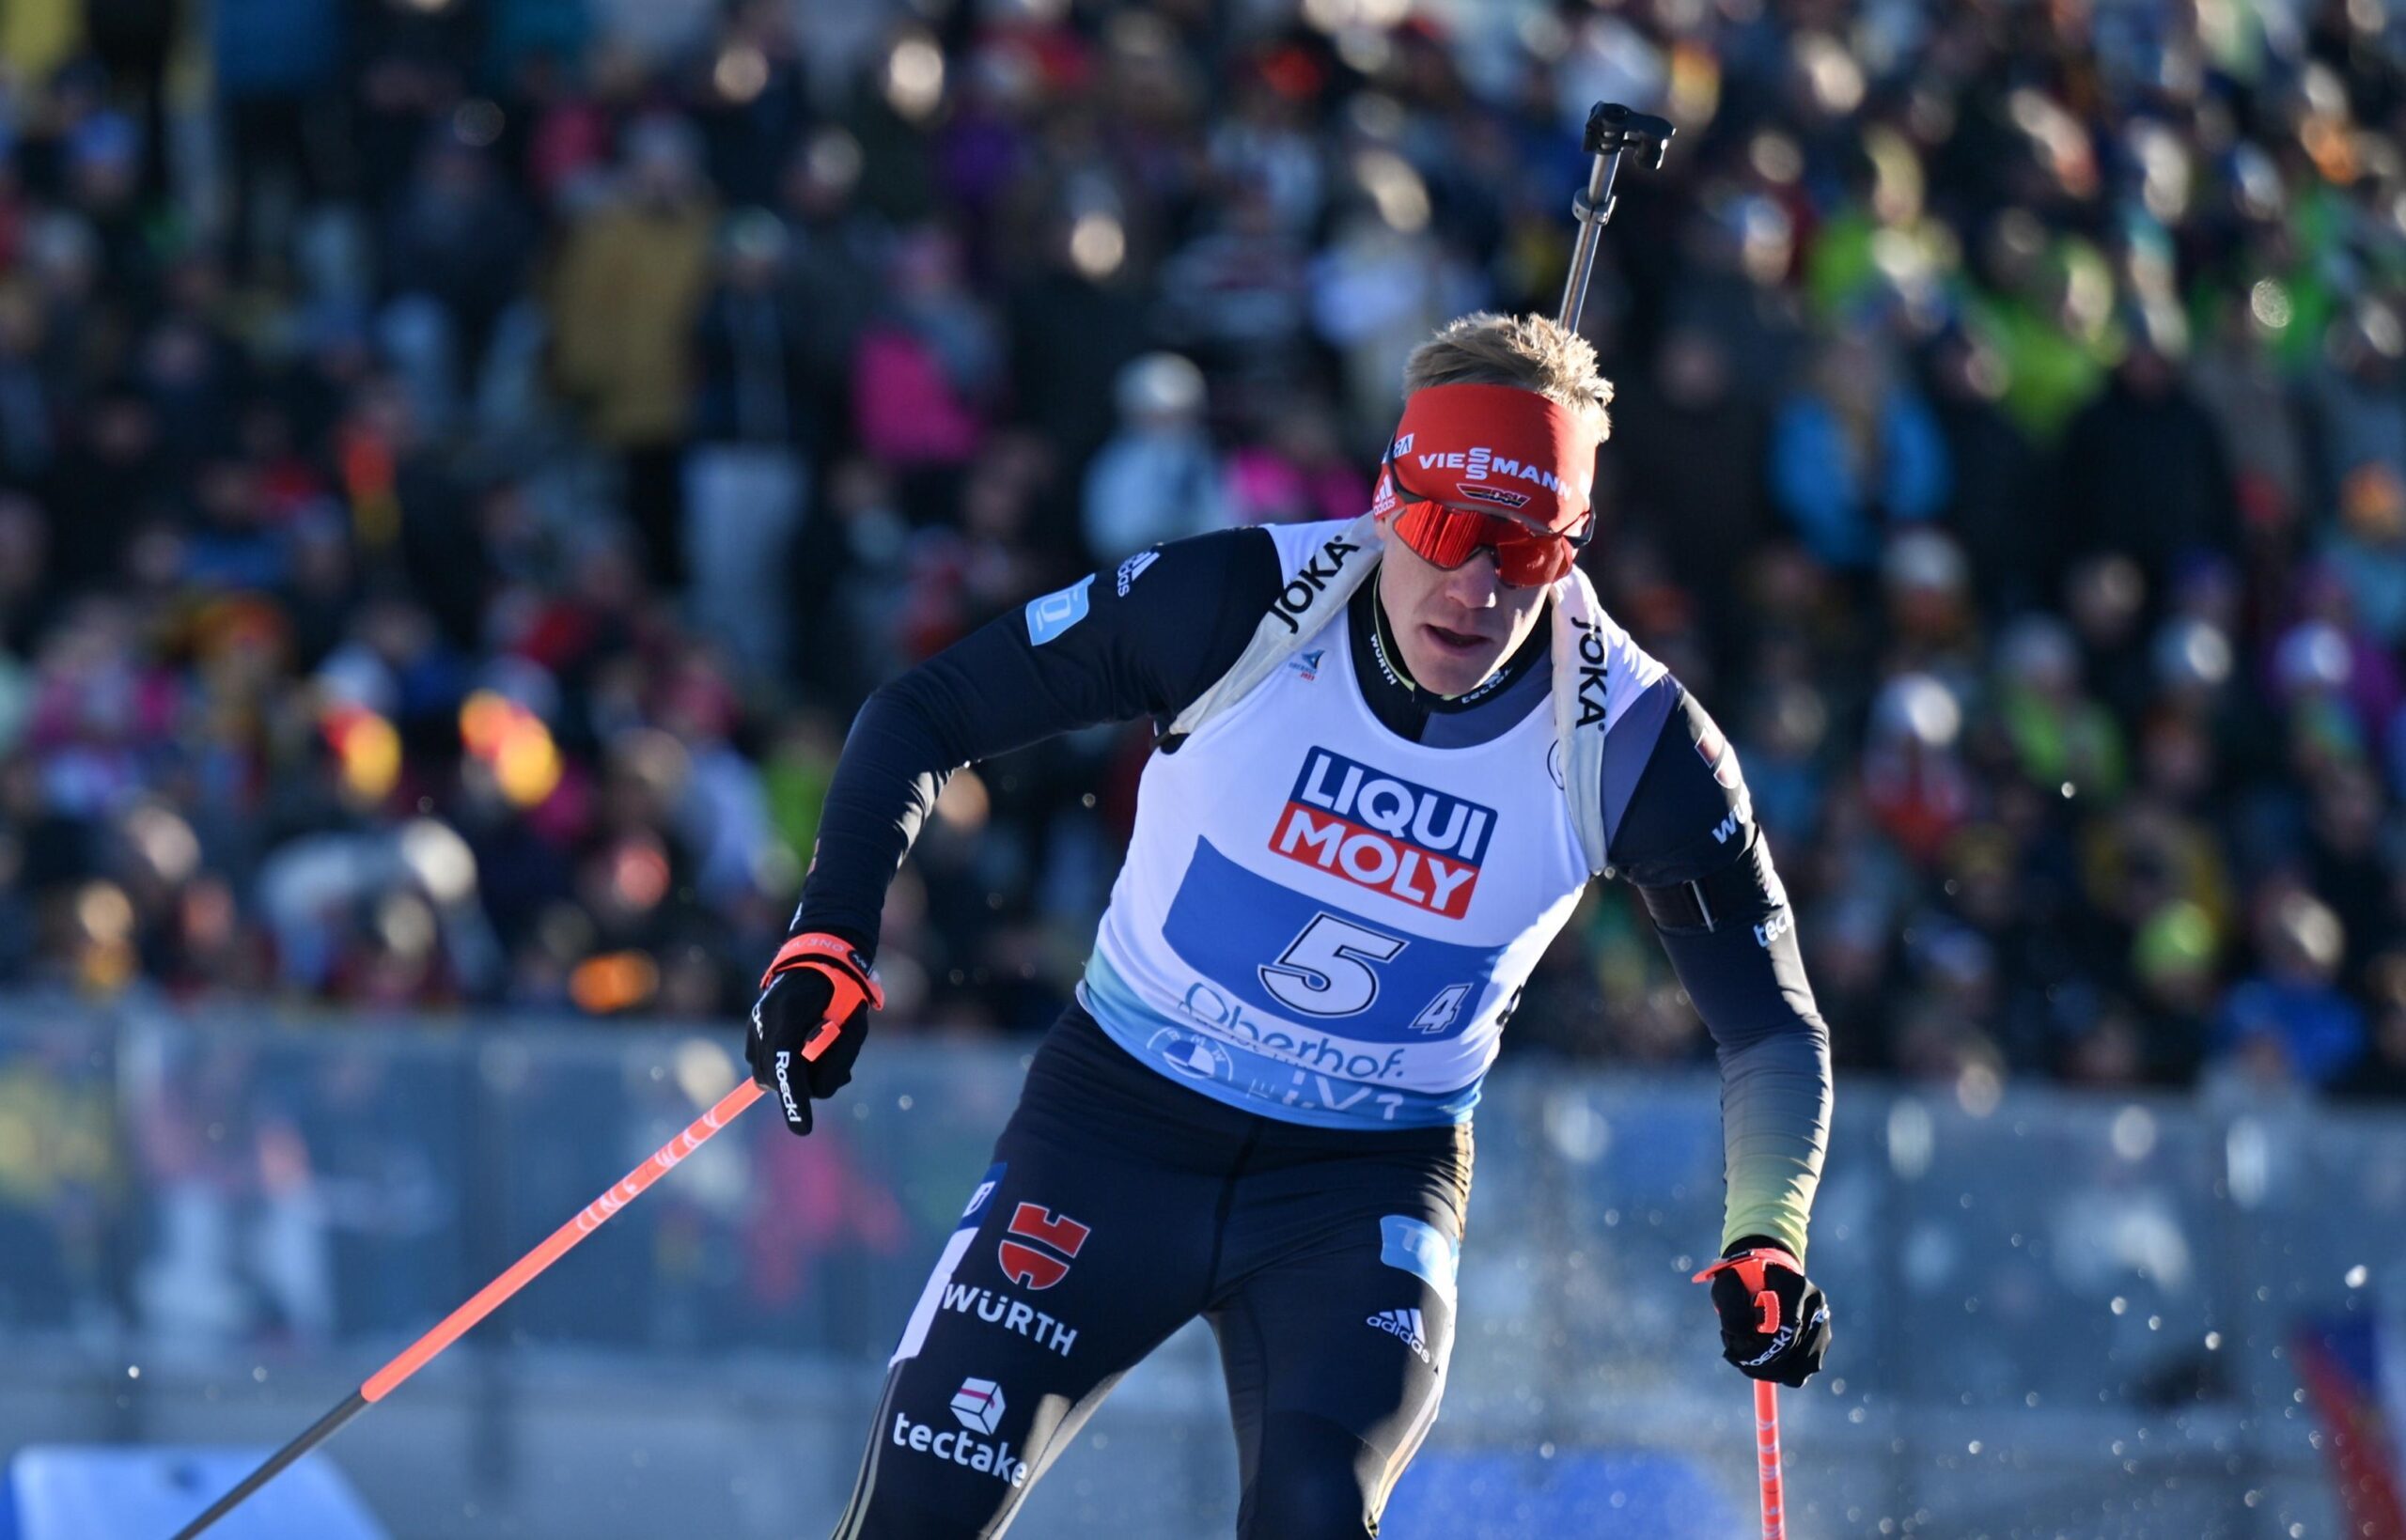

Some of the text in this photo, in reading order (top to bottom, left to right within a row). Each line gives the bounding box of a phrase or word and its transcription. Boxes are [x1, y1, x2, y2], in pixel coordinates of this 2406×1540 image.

[1418, 446, 1572, 502] VIESSMANN
[1270, 537, 1360, 635] JOKA
[1571, 616, 1608, 730] JOKA
[1301, 754, 1488, 861] LIQUI
[1279, 808, 1476, 911] MOLY
[1258, 911, 1410, 1019] 5
[1409, 982, 1475, 1034] 4
[943, 1283, 1078, 1357] WÜRTH
[1367, 1315, 1430, 1364] adidas
[893, 1412, 1028, 1488] tectake
